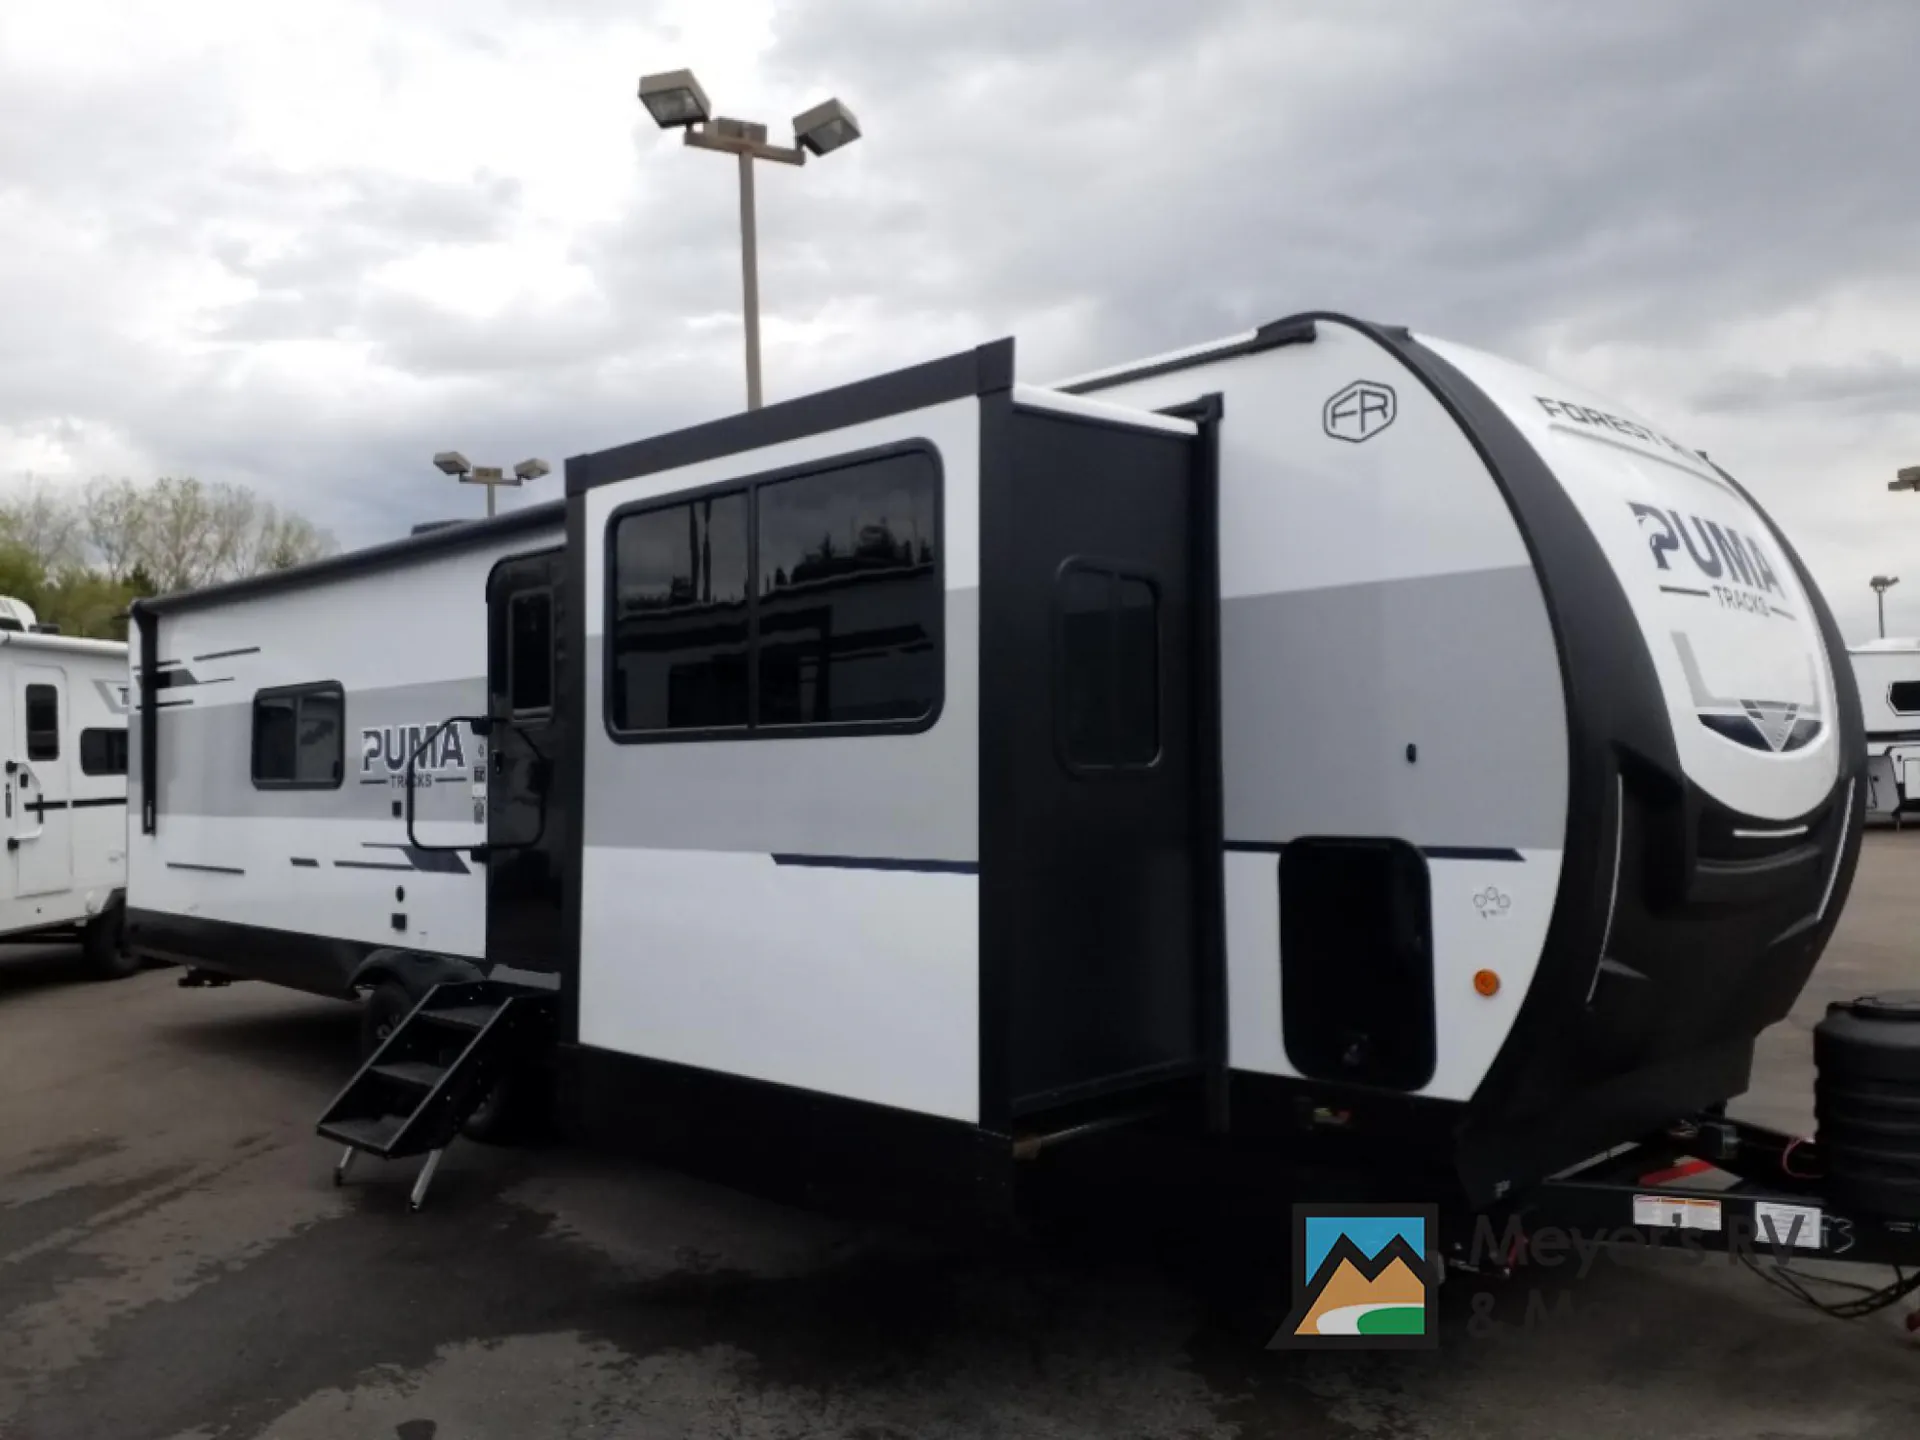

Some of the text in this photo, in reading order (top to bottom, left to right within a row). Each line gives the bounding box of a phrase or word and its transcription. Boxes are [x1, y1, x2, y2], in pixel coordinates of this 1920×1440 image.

[1534, 396, 1662, 446] FOREST
[1627, 499, 1785, 602] PUMA
[1711, 585, 1771, 618] TRACKS
[361, 721, 466, 772] PUMA
[390, 774, 432, 789] TRCKS
